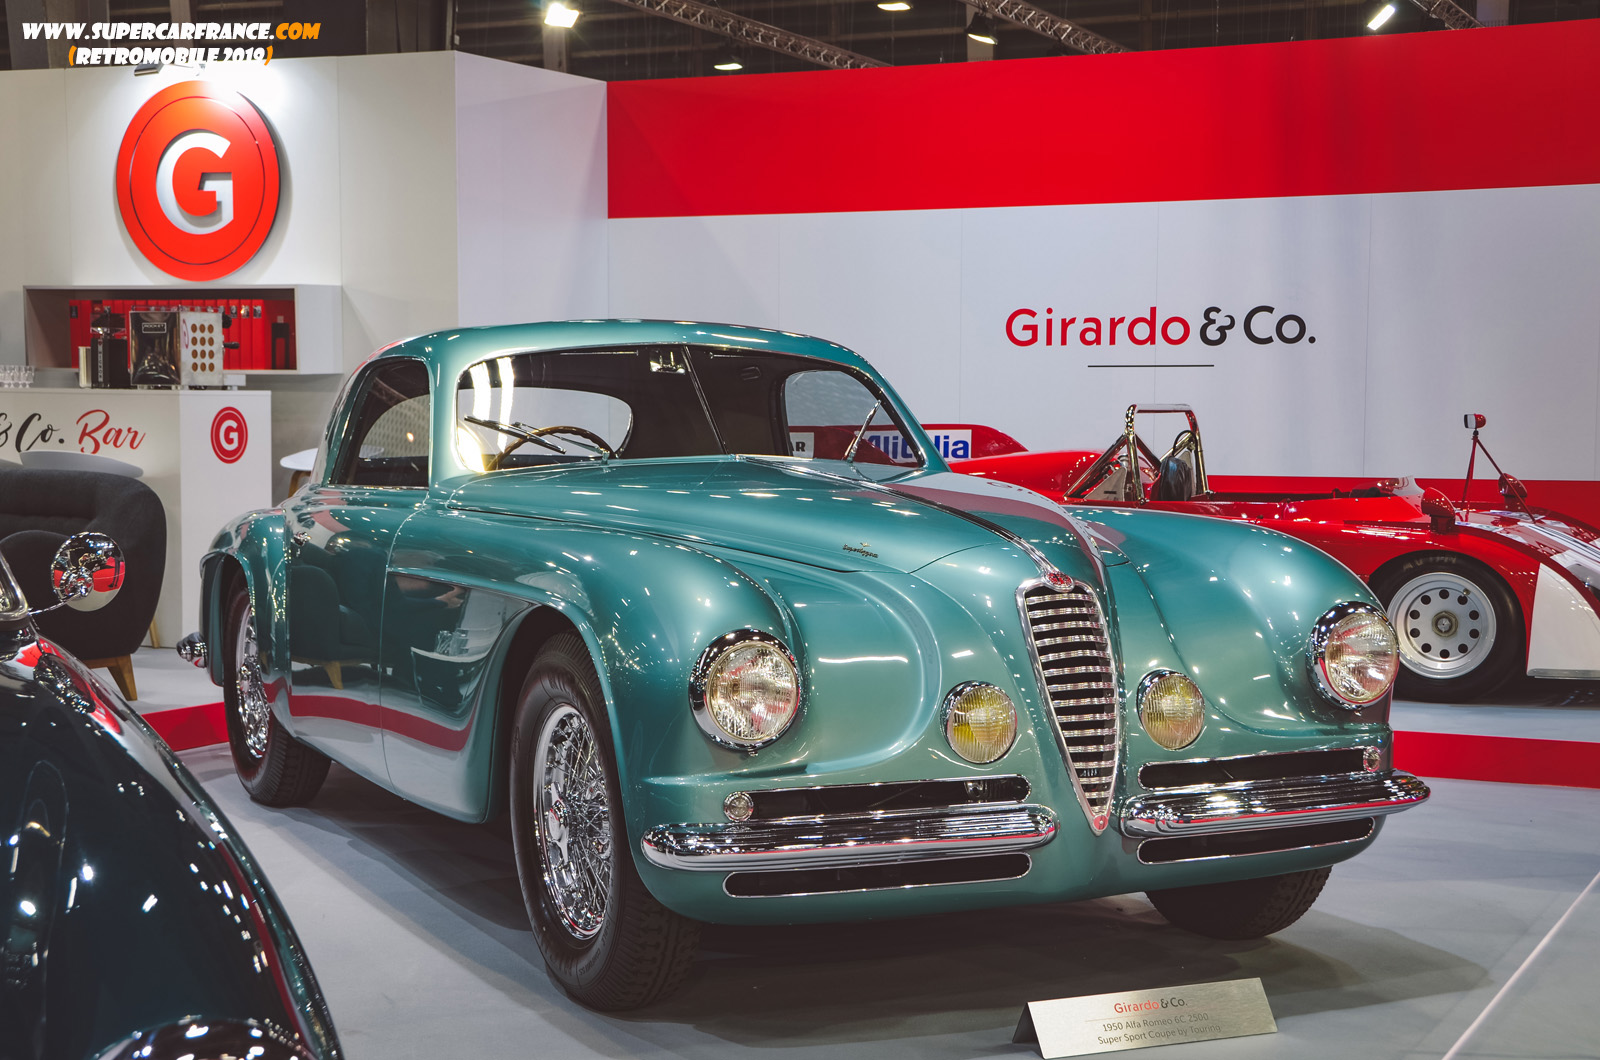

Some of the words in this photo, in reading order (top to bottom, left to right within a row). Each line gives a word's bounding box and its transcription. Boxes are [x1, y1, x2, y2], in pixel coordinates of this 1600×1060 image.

[156, 131, 234, 236] G
[76, 409, 146, 455] Bar
[219, 419, 239, 451] G
[868, 435, 969, 459] Alitlia
[1097, 1035, 1122, 1046] Super
[1123, 1032, 1148, 1043] Sport
[1148, 1029, 1176, 1040] Coupe
[1179, 1026, 1188, 1037] by
[1190, 1024, 1222, 1036] Touring
[1102, 1022, 1124, 1032] 1950
[1125, 1020, 1142, 1030] Alfa
[1143, 1017, 1173, 1028] Romeo
[1174, 1015, 1187, 1025] 6C
[1188, 1012, 1209, 1023] 2500
